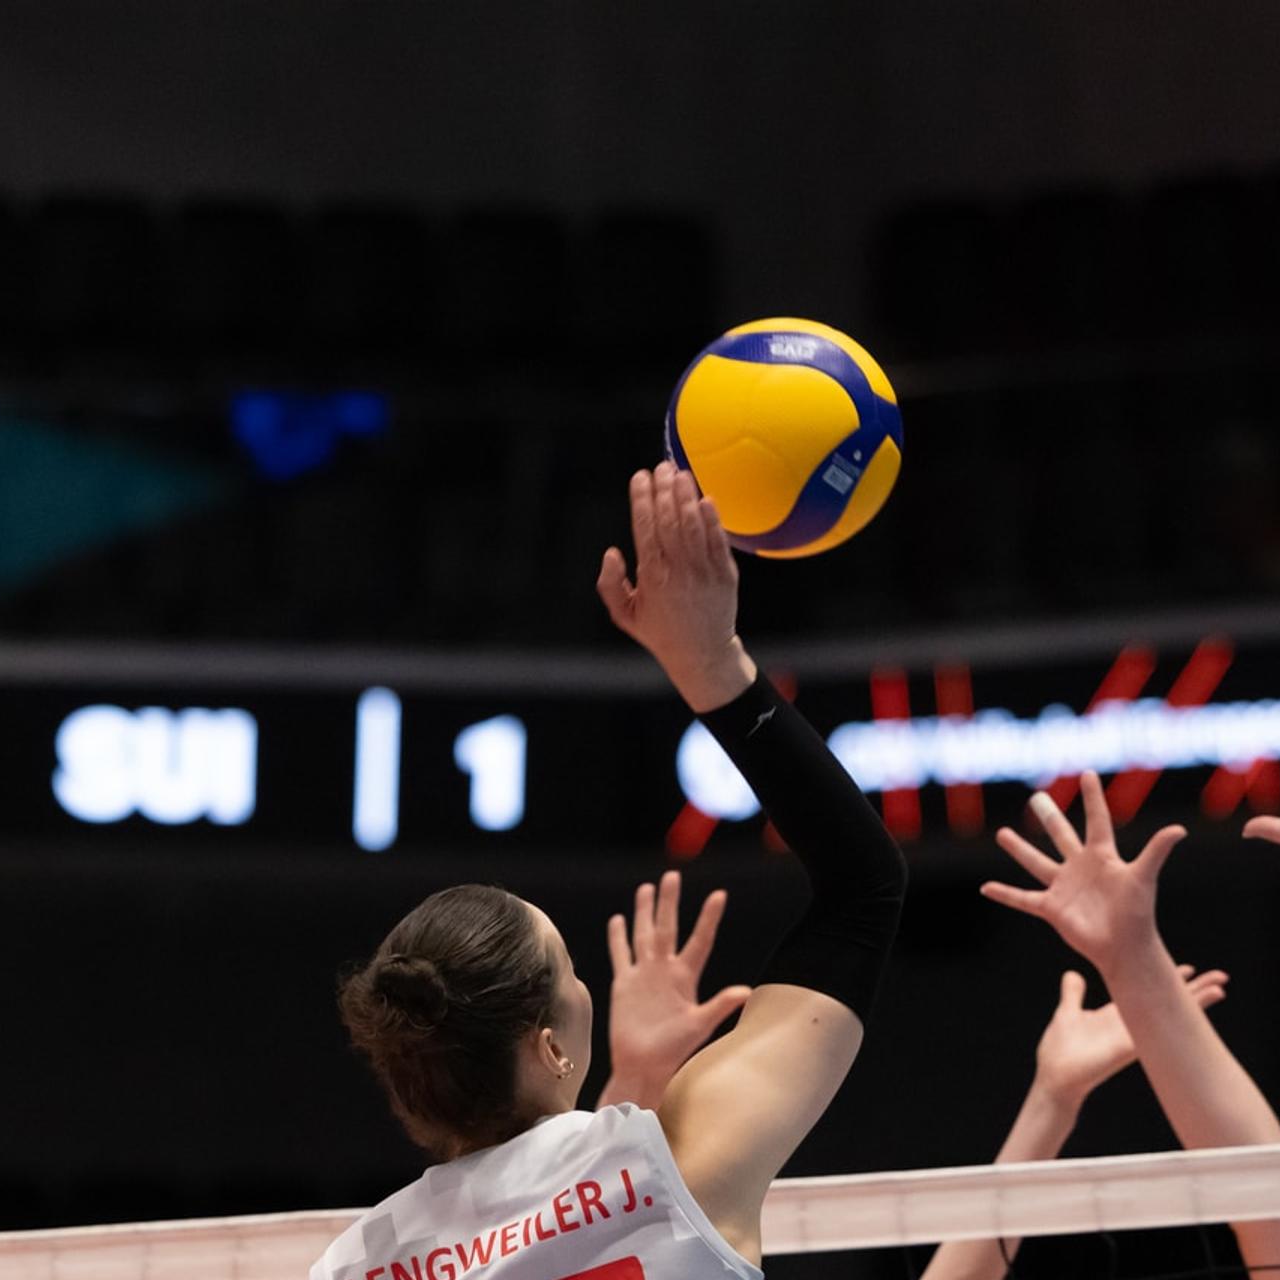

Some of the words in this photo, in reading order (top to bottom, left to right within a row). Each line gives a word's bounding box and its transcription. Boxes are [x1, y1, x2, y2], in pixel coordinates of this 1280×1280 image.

[54, 706, 257, 825] SUI
[455, 718, 525, 830] 1
[620, 1169, 653, 1212] J.
